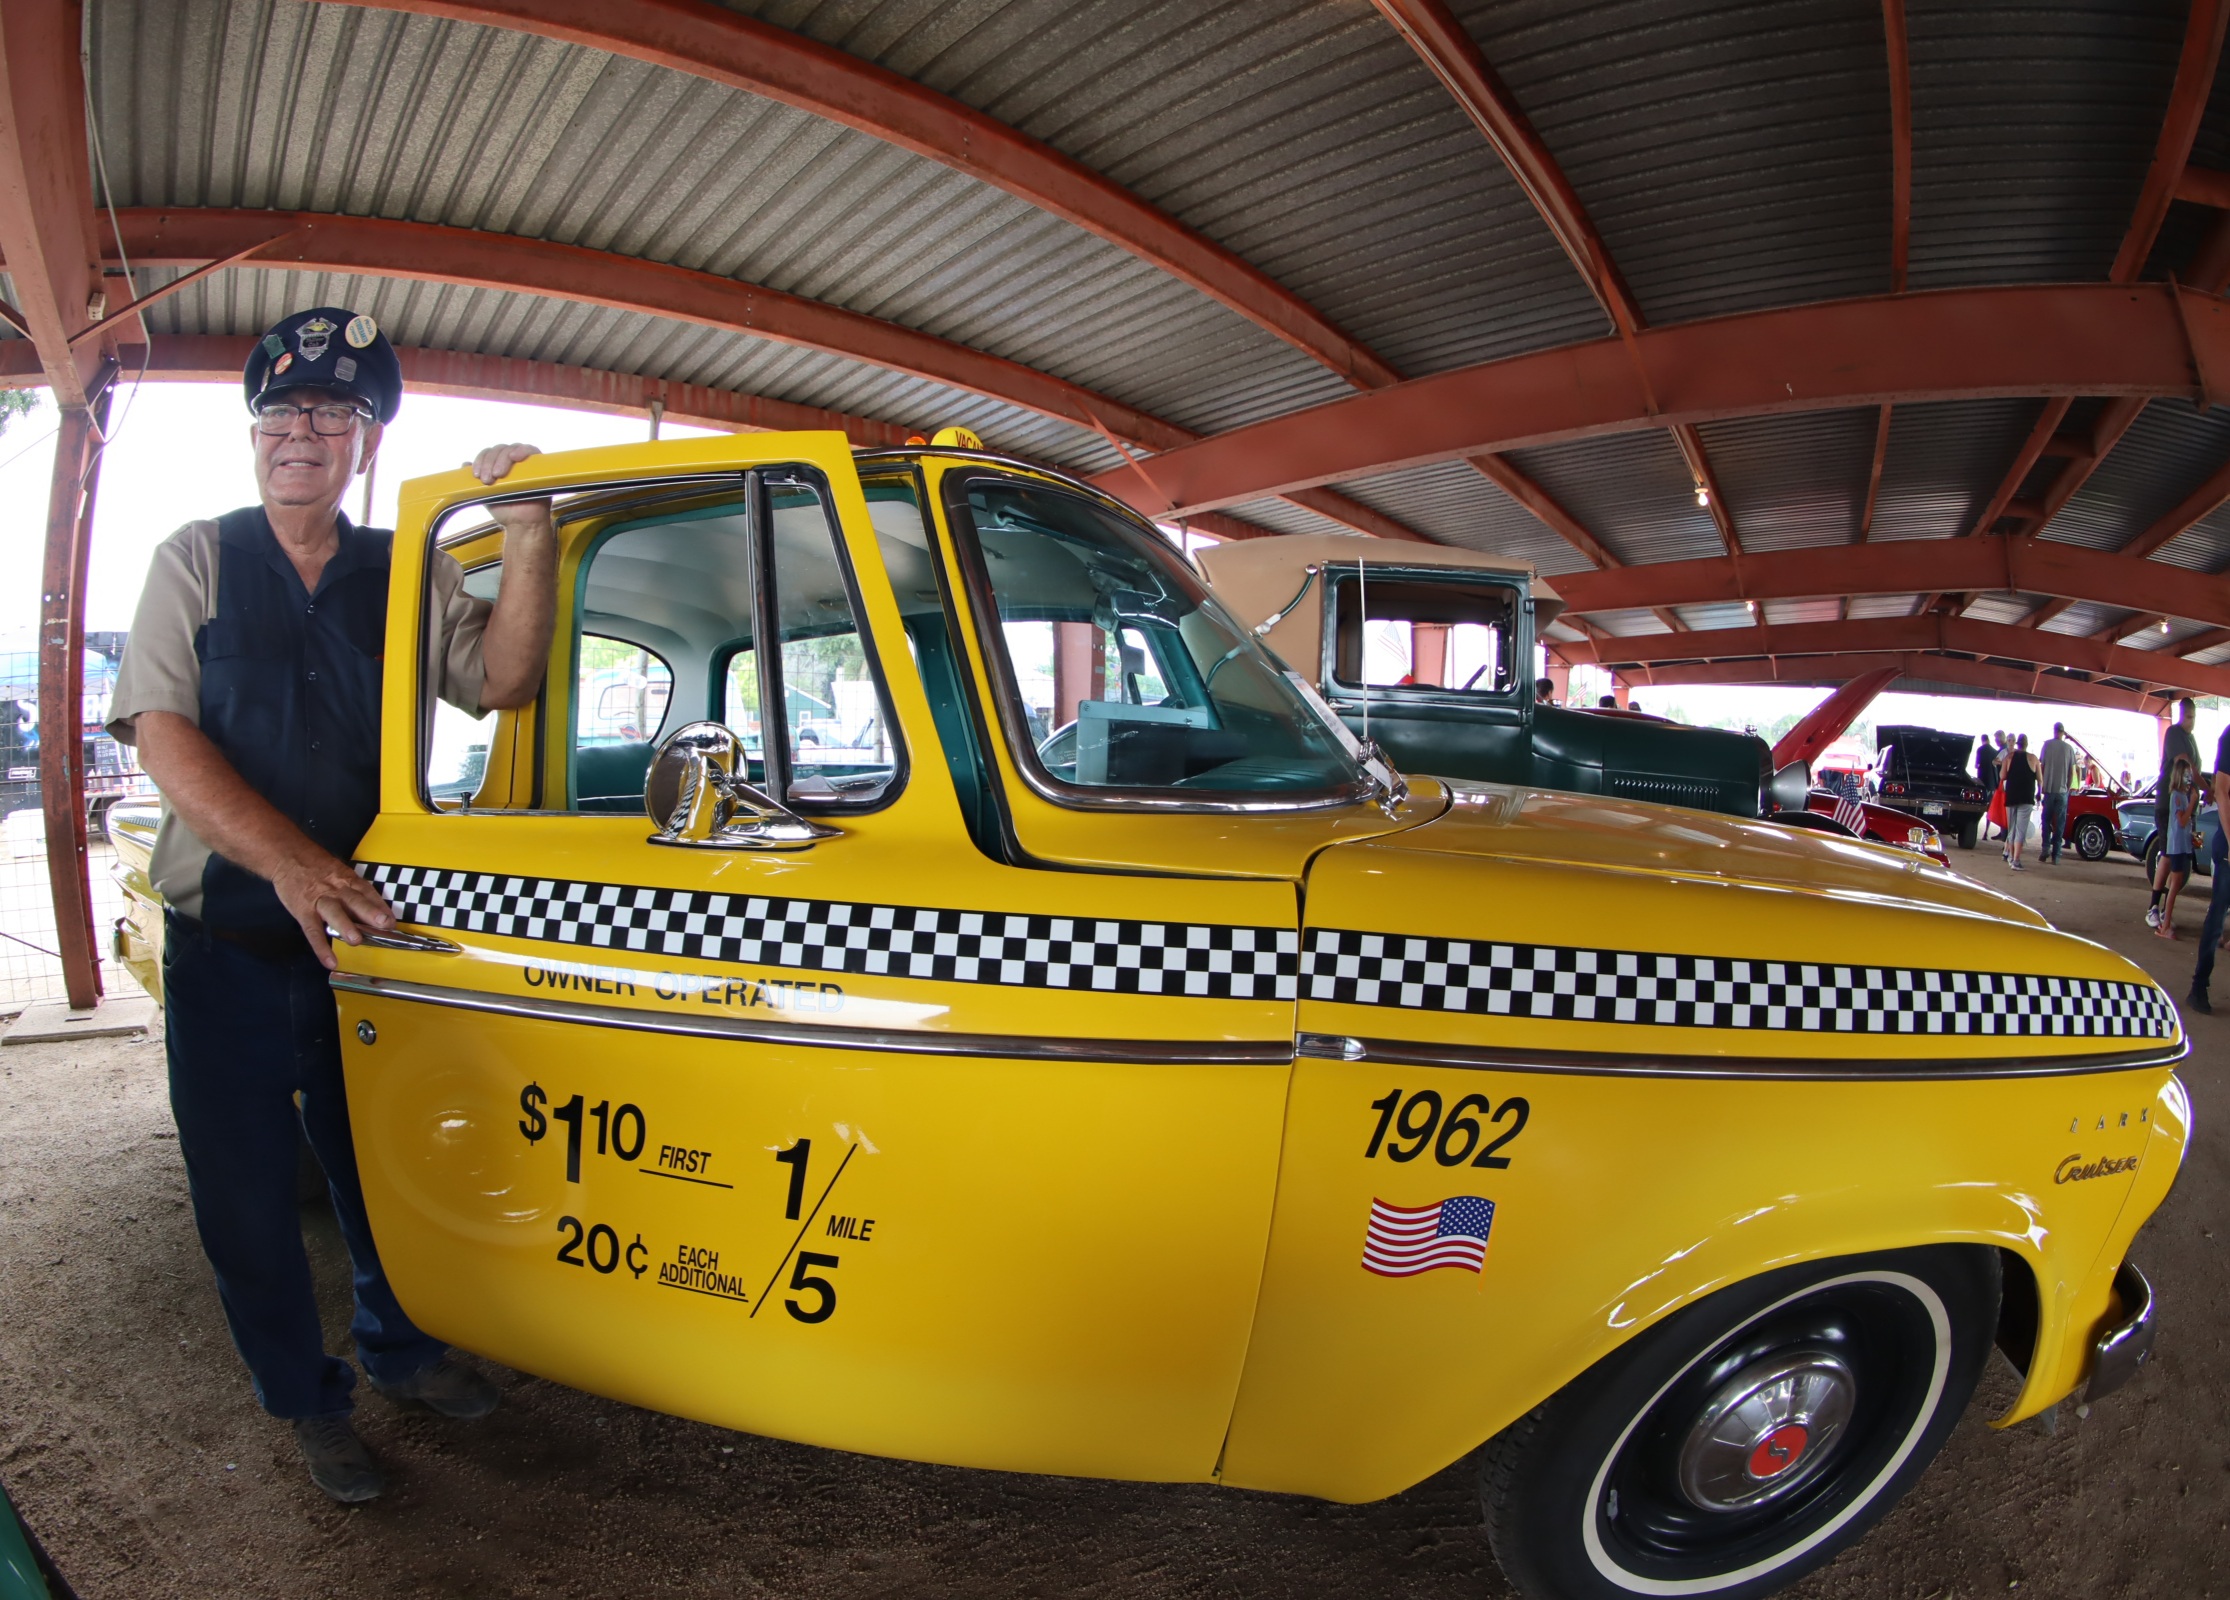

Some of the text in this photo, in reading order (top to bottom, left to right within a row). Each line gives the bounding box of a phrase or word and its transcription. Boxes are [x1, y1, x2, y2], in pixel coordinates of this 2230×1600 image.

[523, 958, 845, 1014] OWNER OPERATED
[1365, 1088, 1530, 1170] 1962
[658, 1145, 712, 1175] FIRST
[825, 1214, 875, 1242] MILE
[677, 1244, 719, 1271] EACH
[658, 1262, 746, 1297] ADDITIONAL
